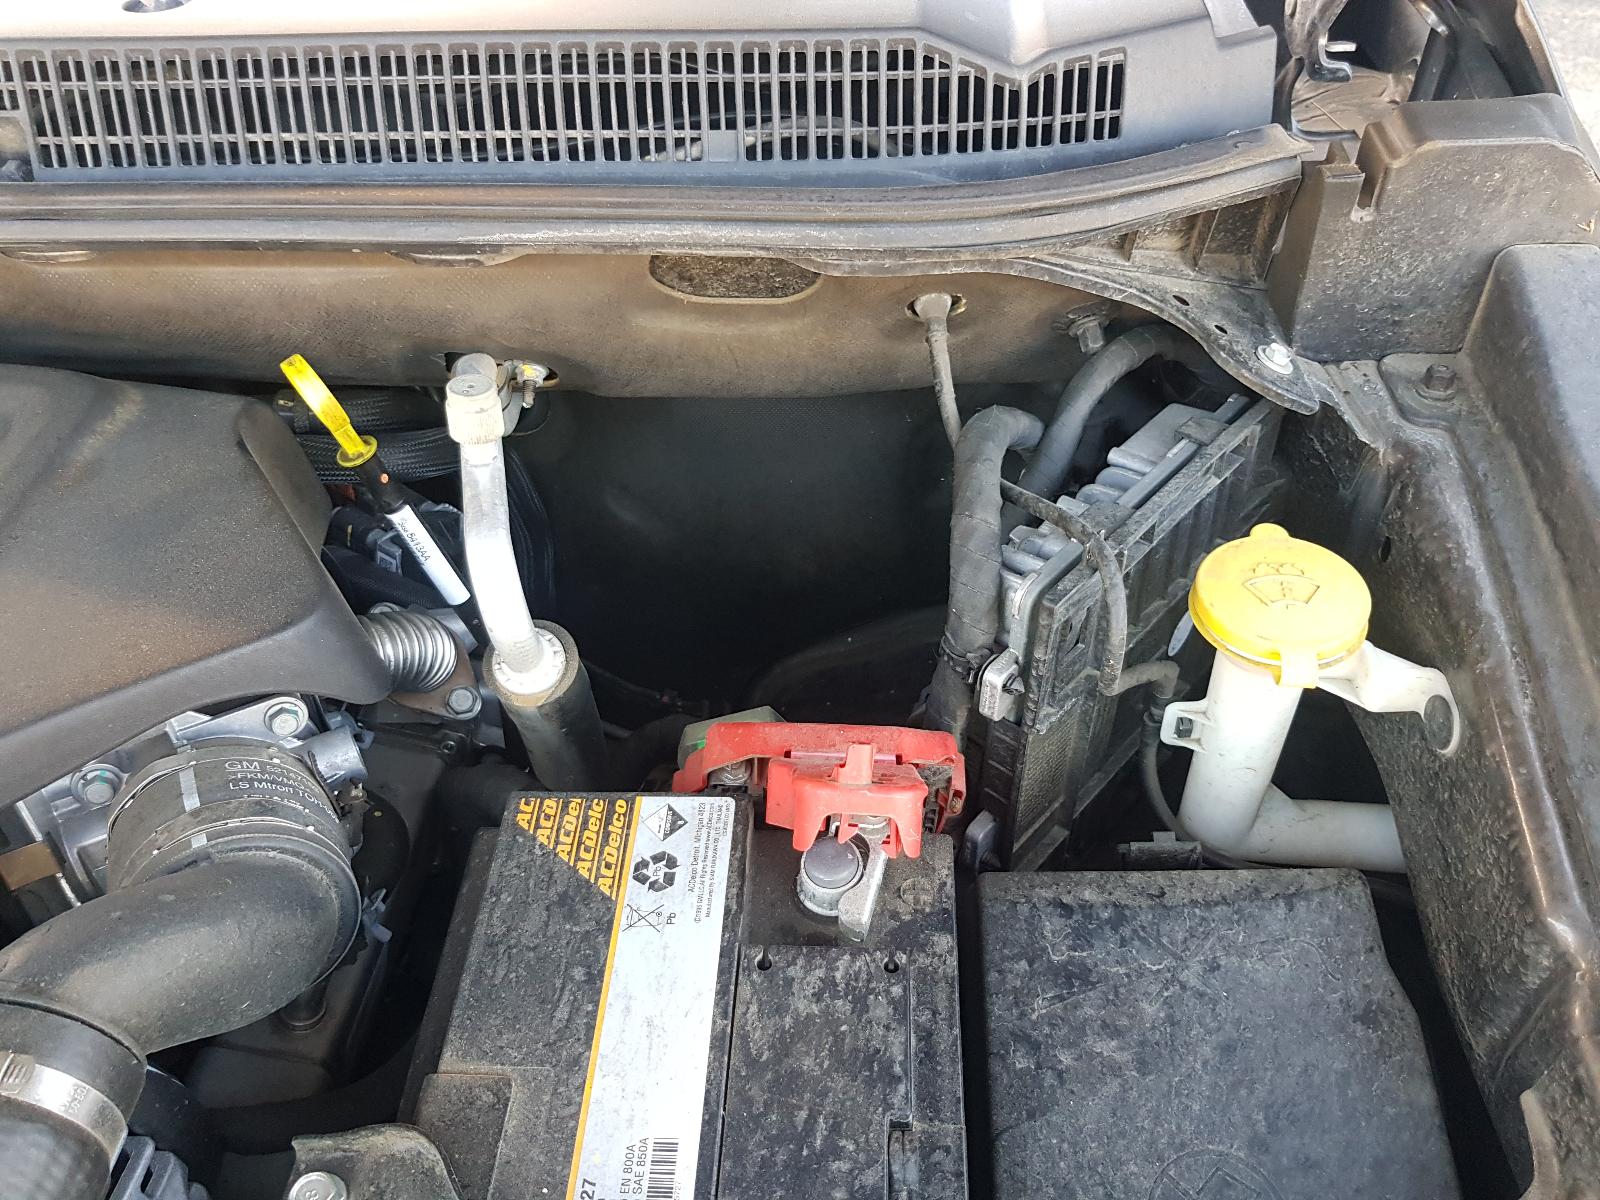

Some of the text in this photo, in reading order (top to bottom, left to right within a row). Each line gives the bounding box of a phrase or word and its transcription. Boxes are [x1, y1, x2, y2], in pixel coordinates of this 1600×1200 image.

[224, 760, 261, 771] GM
[229, 781, 250, 790] LS
[597, 799, 628, 901] ACDelco
[652, 865, 662, 877] Pb
[665, 912, 677, 925] Pb
[620, 1144, 636, 1194] EN 800A
[632, 1137, 649, 1194] SAE 850A
